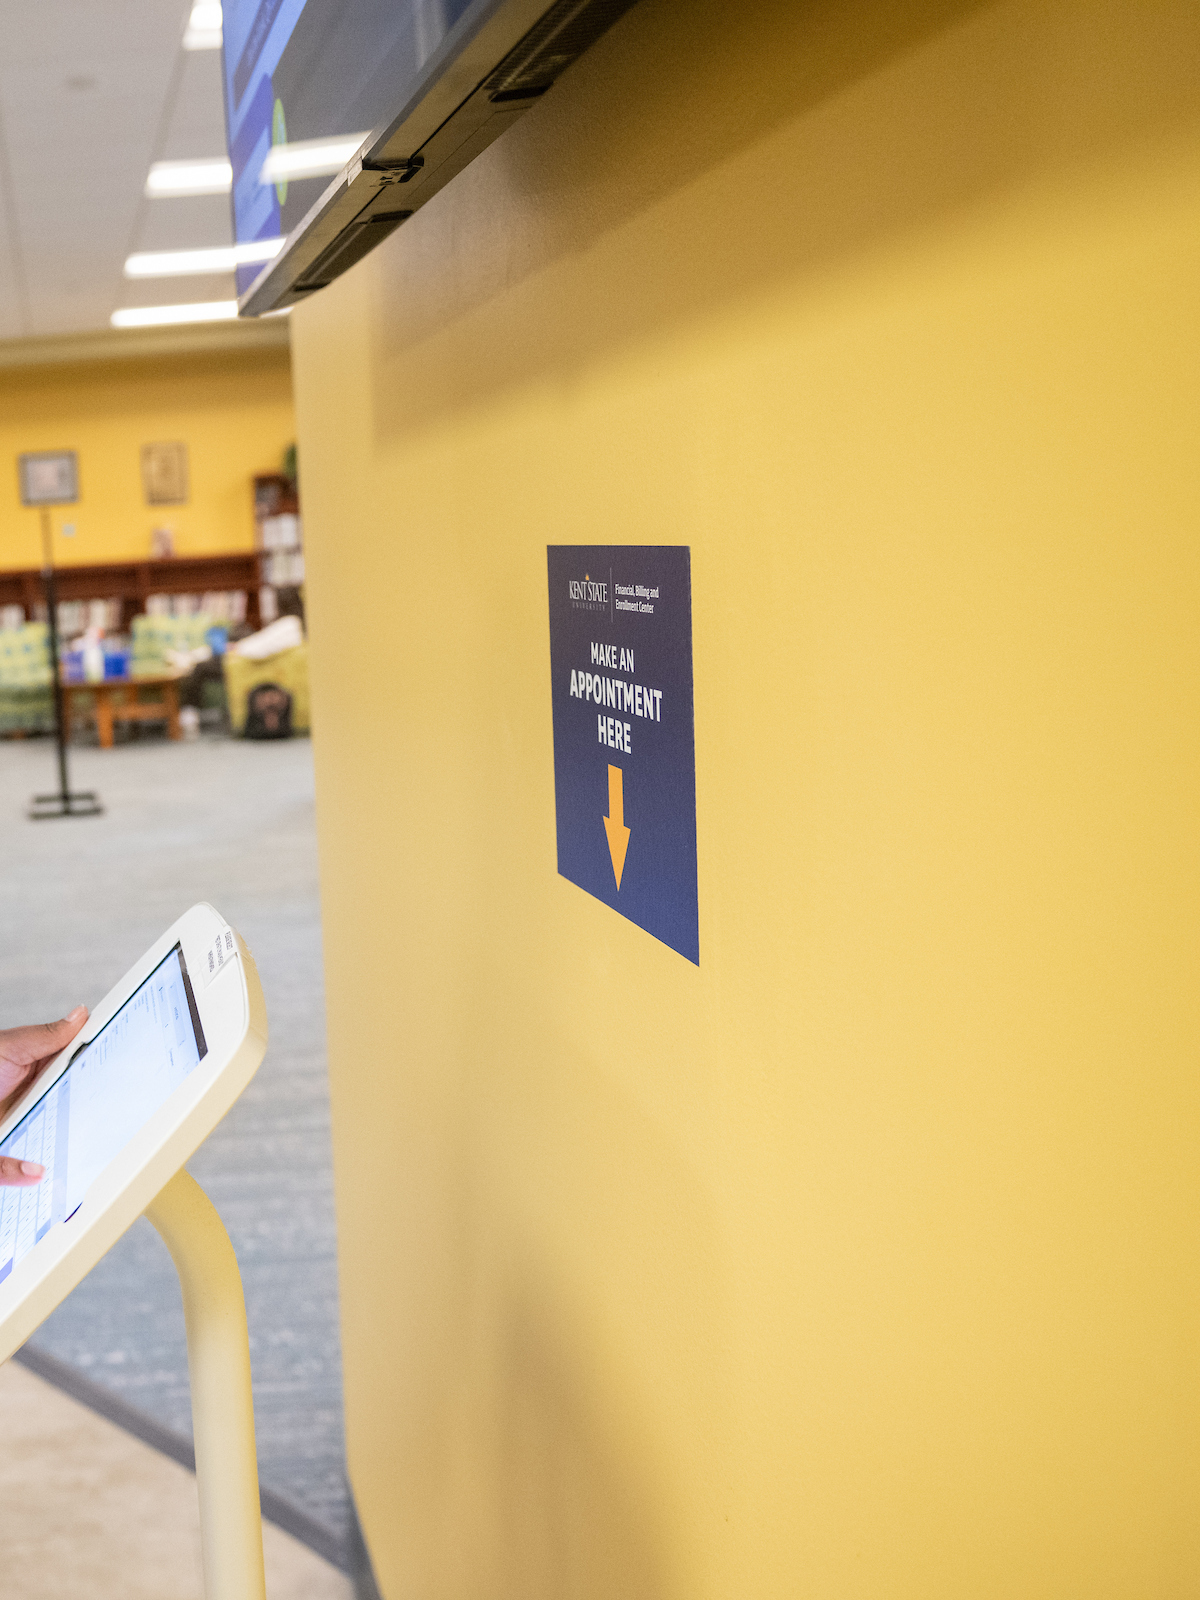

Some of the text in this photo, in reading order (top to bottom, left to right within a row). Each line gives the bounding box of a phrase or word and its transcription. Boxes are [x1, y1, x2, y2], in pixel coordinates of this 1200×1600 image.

[569, 580, 608, 603] KENT STATE
[615, 584, 659, 600] Financial, Billing and
[572, 601, 606, 612] UNIVERSITY
[615, 599, 654, 613] Enrollment Center
[591, 641, 634, 673] MAKE AN
[569, 669, 663, 722] APPOINTMENT
[598, 714, 632, 754] HERE
